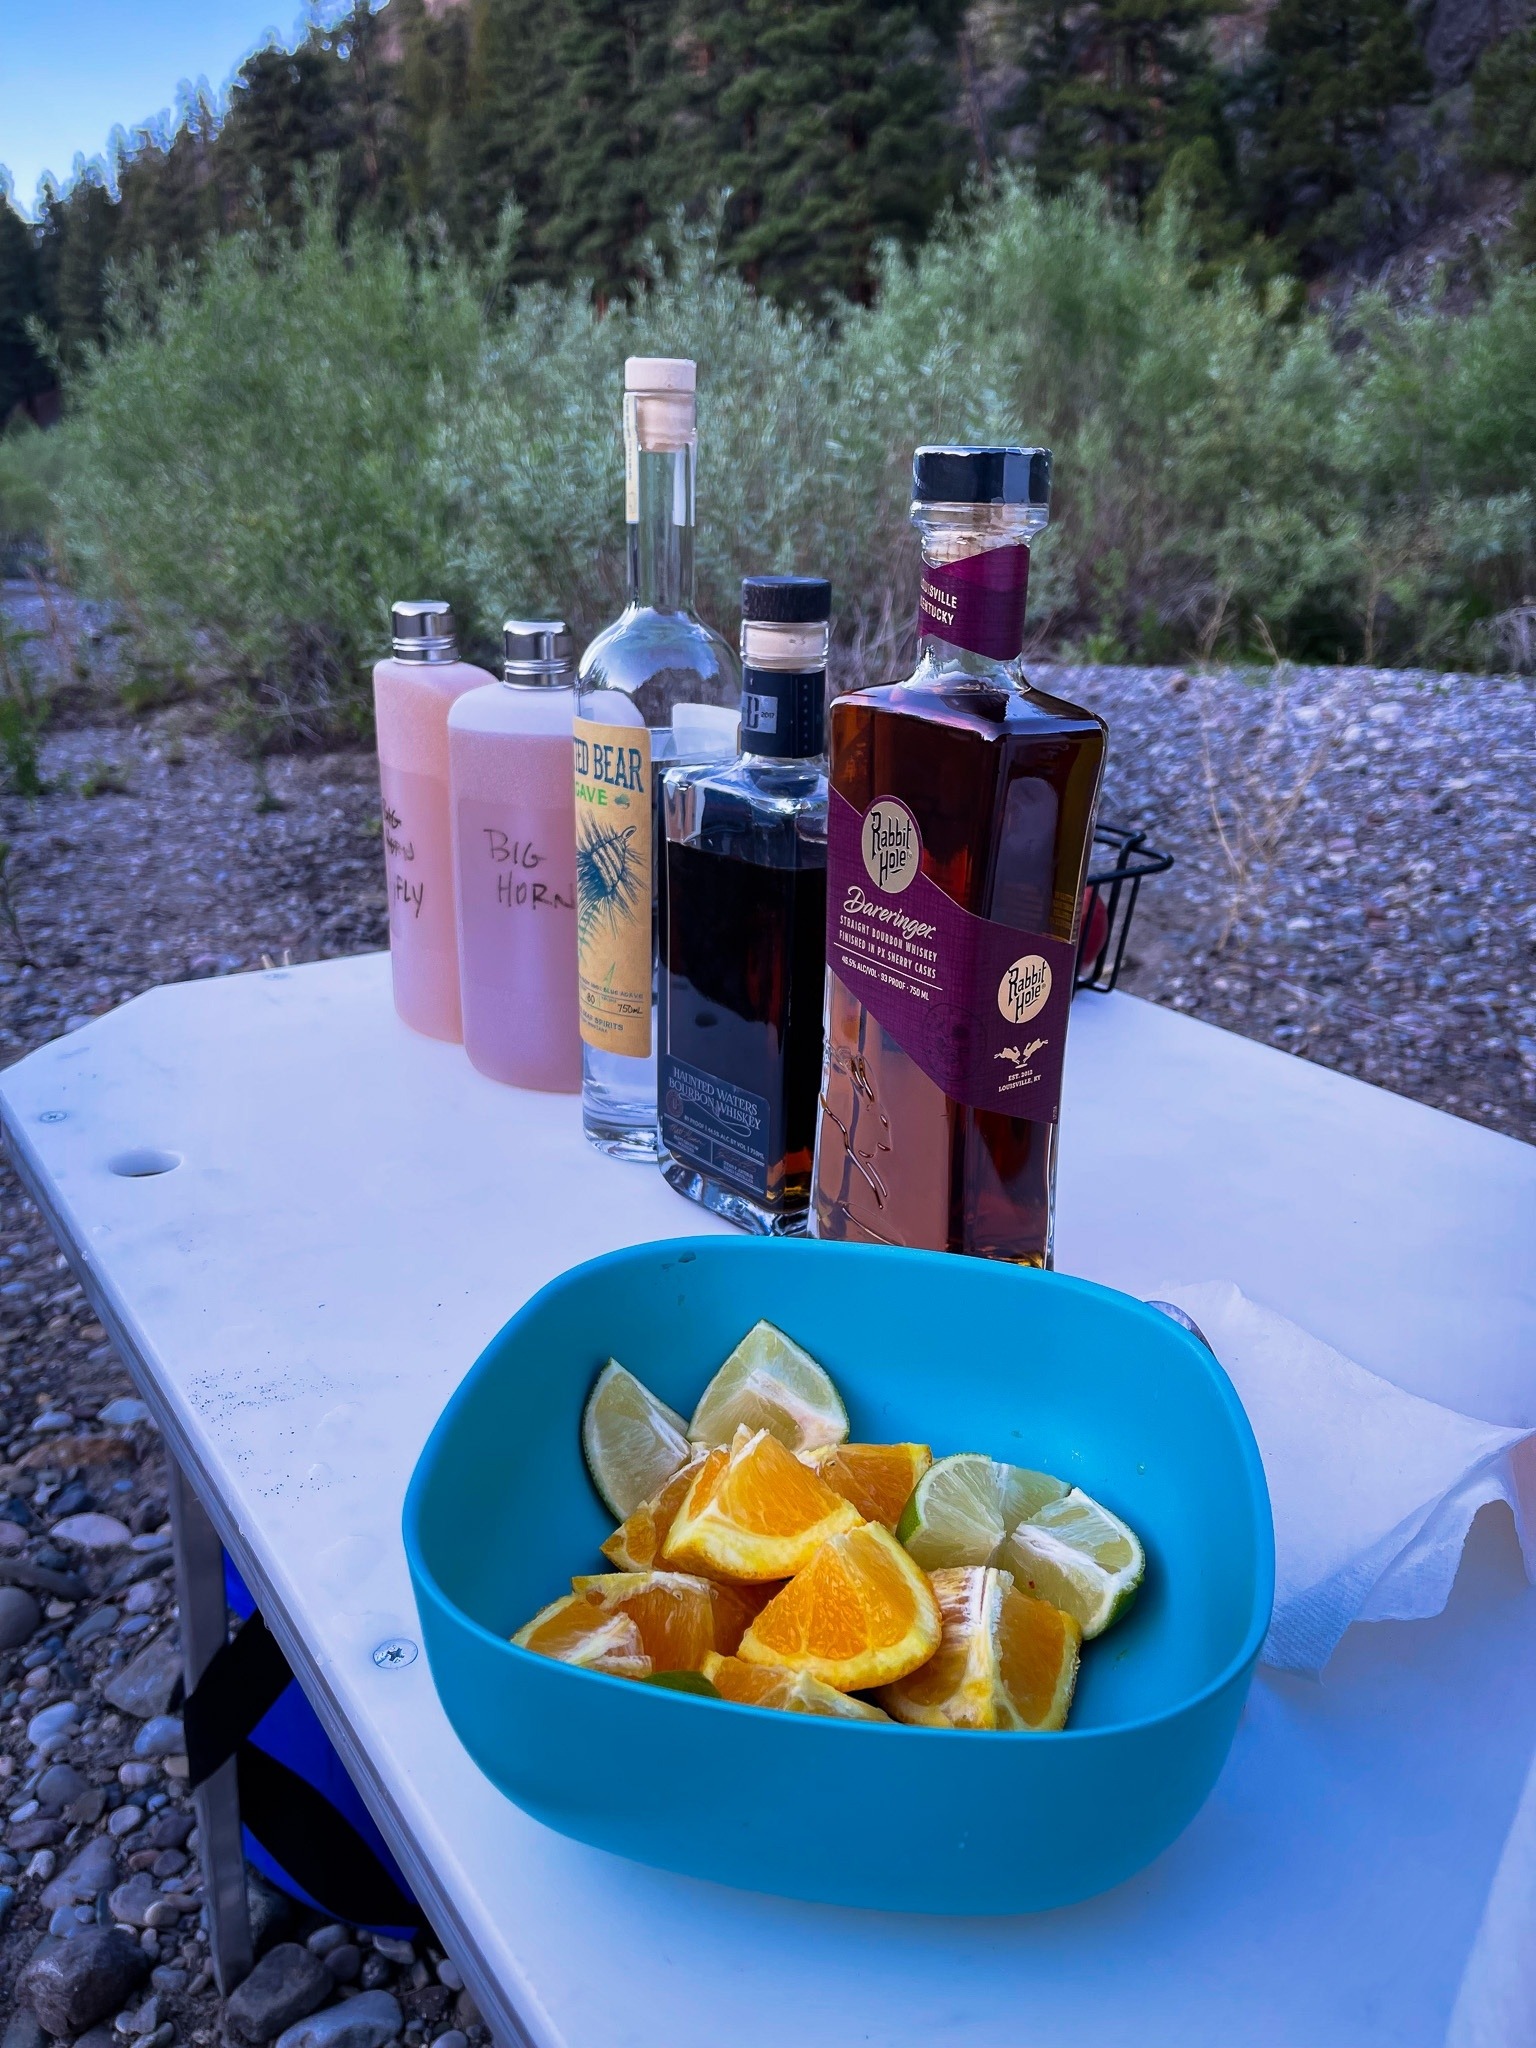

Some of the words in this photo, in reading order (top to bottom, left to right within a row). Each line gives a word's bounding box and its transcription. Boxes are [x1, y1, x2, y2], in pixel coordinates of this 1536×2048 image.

[593, 743, 645, 793] BEAR
[483, 829, 547, 869] BIG
[870, 811, 912, 861] Rabbit
[498, 870, 576, 911] HORN
[879, 848, 906, 888] Hole
[843, 885, 937, 940] Dareringer
[839, 914, 870, 936] STRAIGHT
[871, 927, 903, 950] BOURBON
[905, 941, 938, 963] WHISKEY
[839, 929, 866, 950] FINISHED
[867, 942, 875, 954] IN
[876, 946, 886, 959] PX
[887, 950, 913, 970] SHERRY
[914, 962, 936, 979] CASKS
[620, 991, 644, 1000] AGAVE
[841, 955, 857, 969] 46.5%
[880, 972, 888, 983] 93
[888, 975, 906, 990] PROOF
[909, 985, 921, 997] 750
[921, 990, 930, 1001] ML
[1008, 961, 1047, 1007] Rabbit
[594, 1016, 624, 1031] SPIRITS
[1015, 985, 1041, 1023] Hole
[673, 1066, 715, 1096] HAUNTED
[716, 1087, 758, 1116] WATERS
[998, 1077, 1033, 1093] LOUISVILLE,
[1033, 1074, 1042, 1082] KY
[1008, 1073, 1020, 1081] EST.
[668, 1076, 715, 1109] BOURBON
[716, 1100, 761, 1130] WHISKEY
